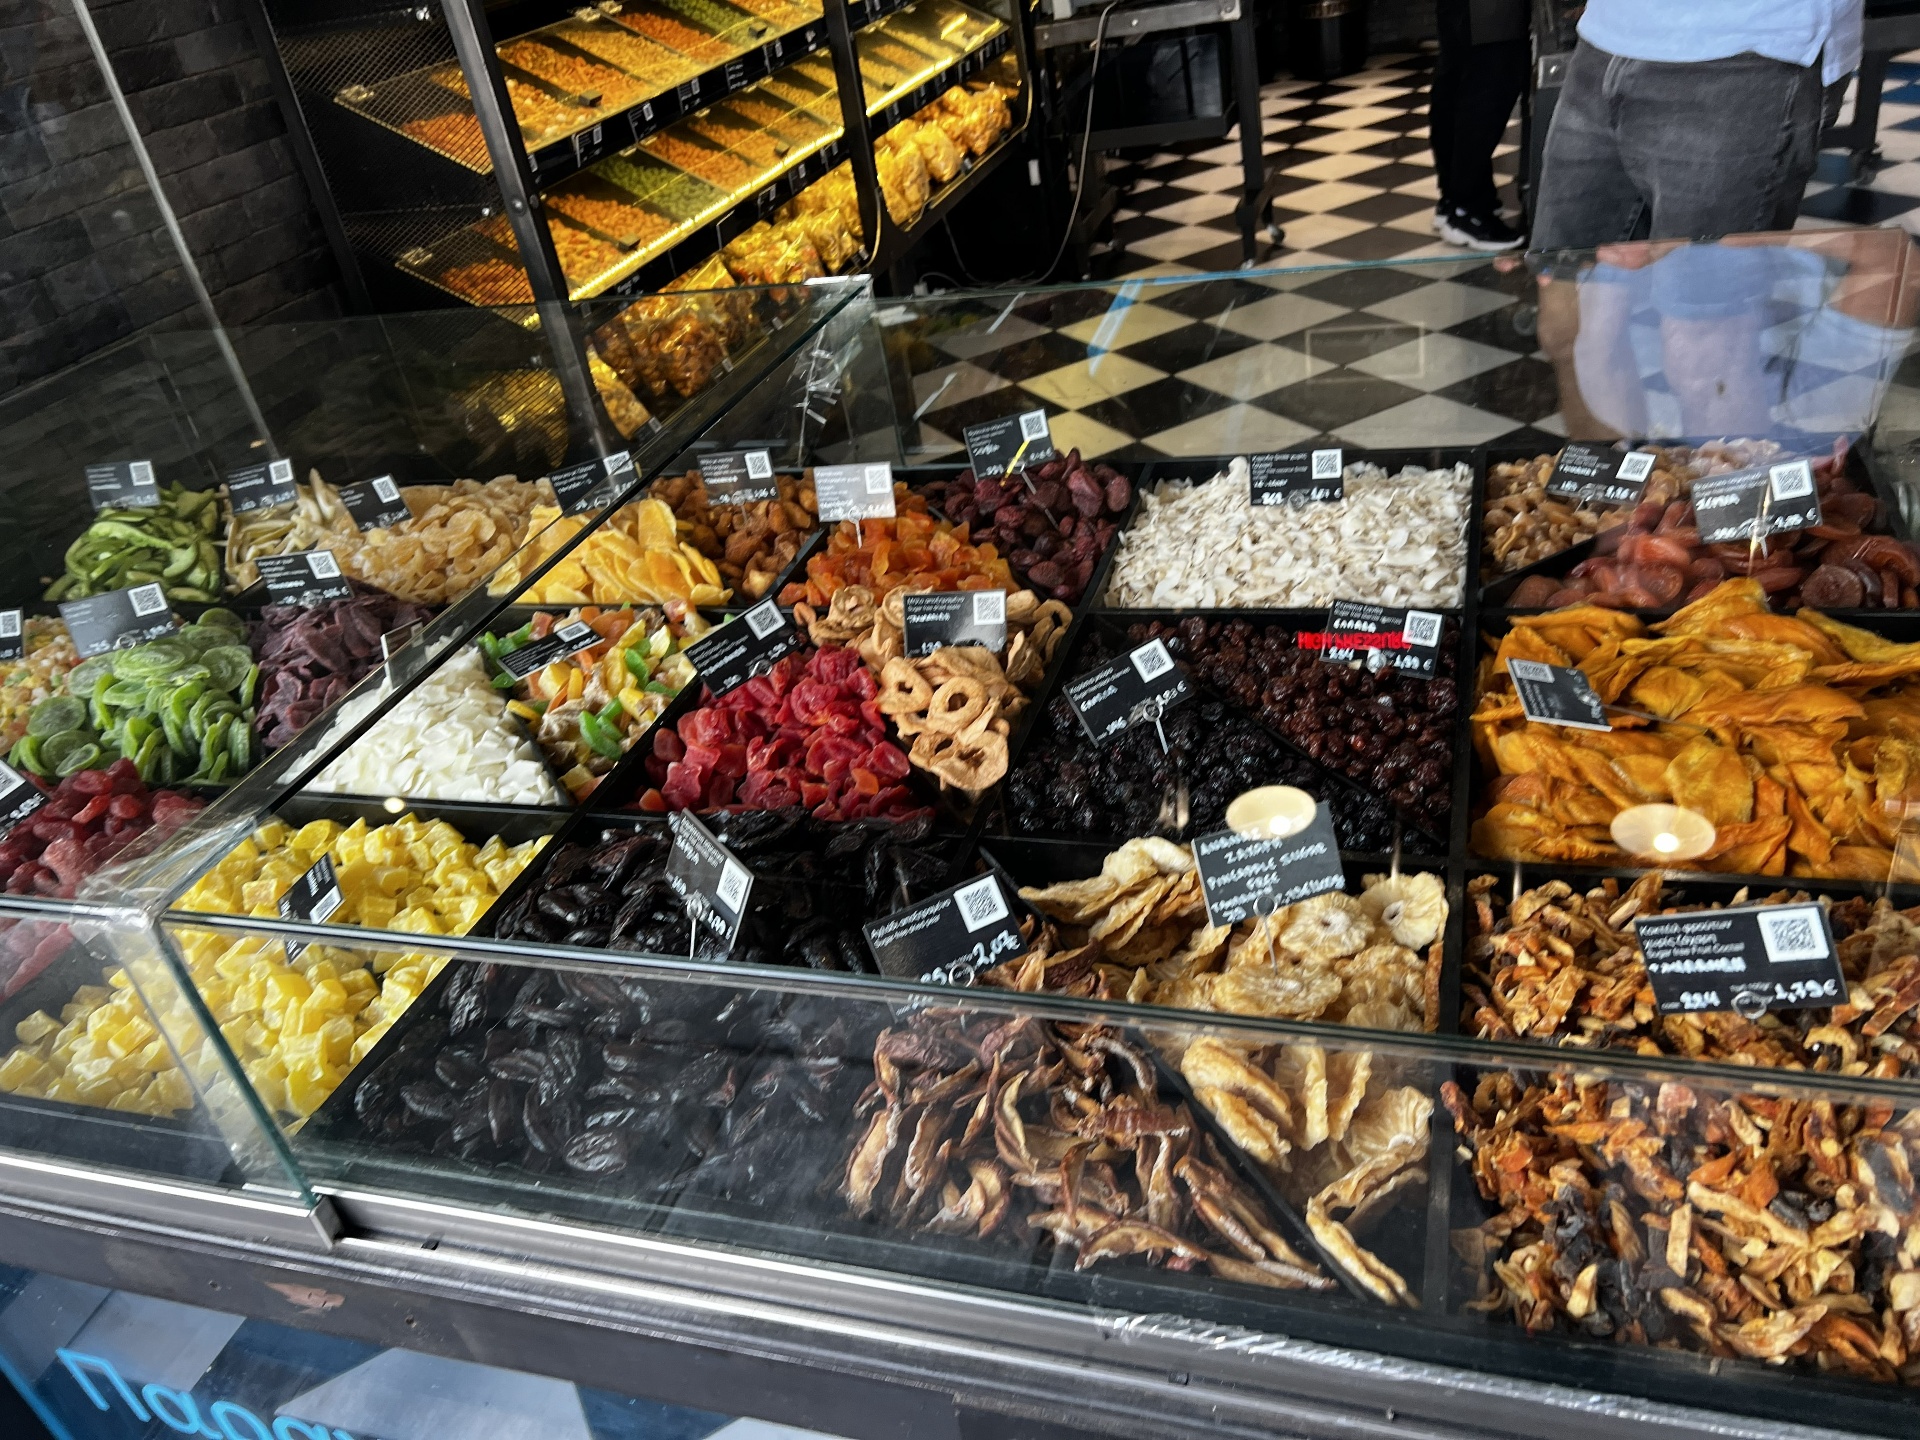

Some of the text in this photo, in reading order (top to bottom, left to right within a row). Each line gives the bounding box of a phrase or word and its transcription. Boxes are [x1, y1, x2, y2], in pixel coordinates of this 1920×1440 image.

[1206, 841, 1329, 892] PINEAPPLE SUGAR
[1245, 871, 1281, 891] FREE
